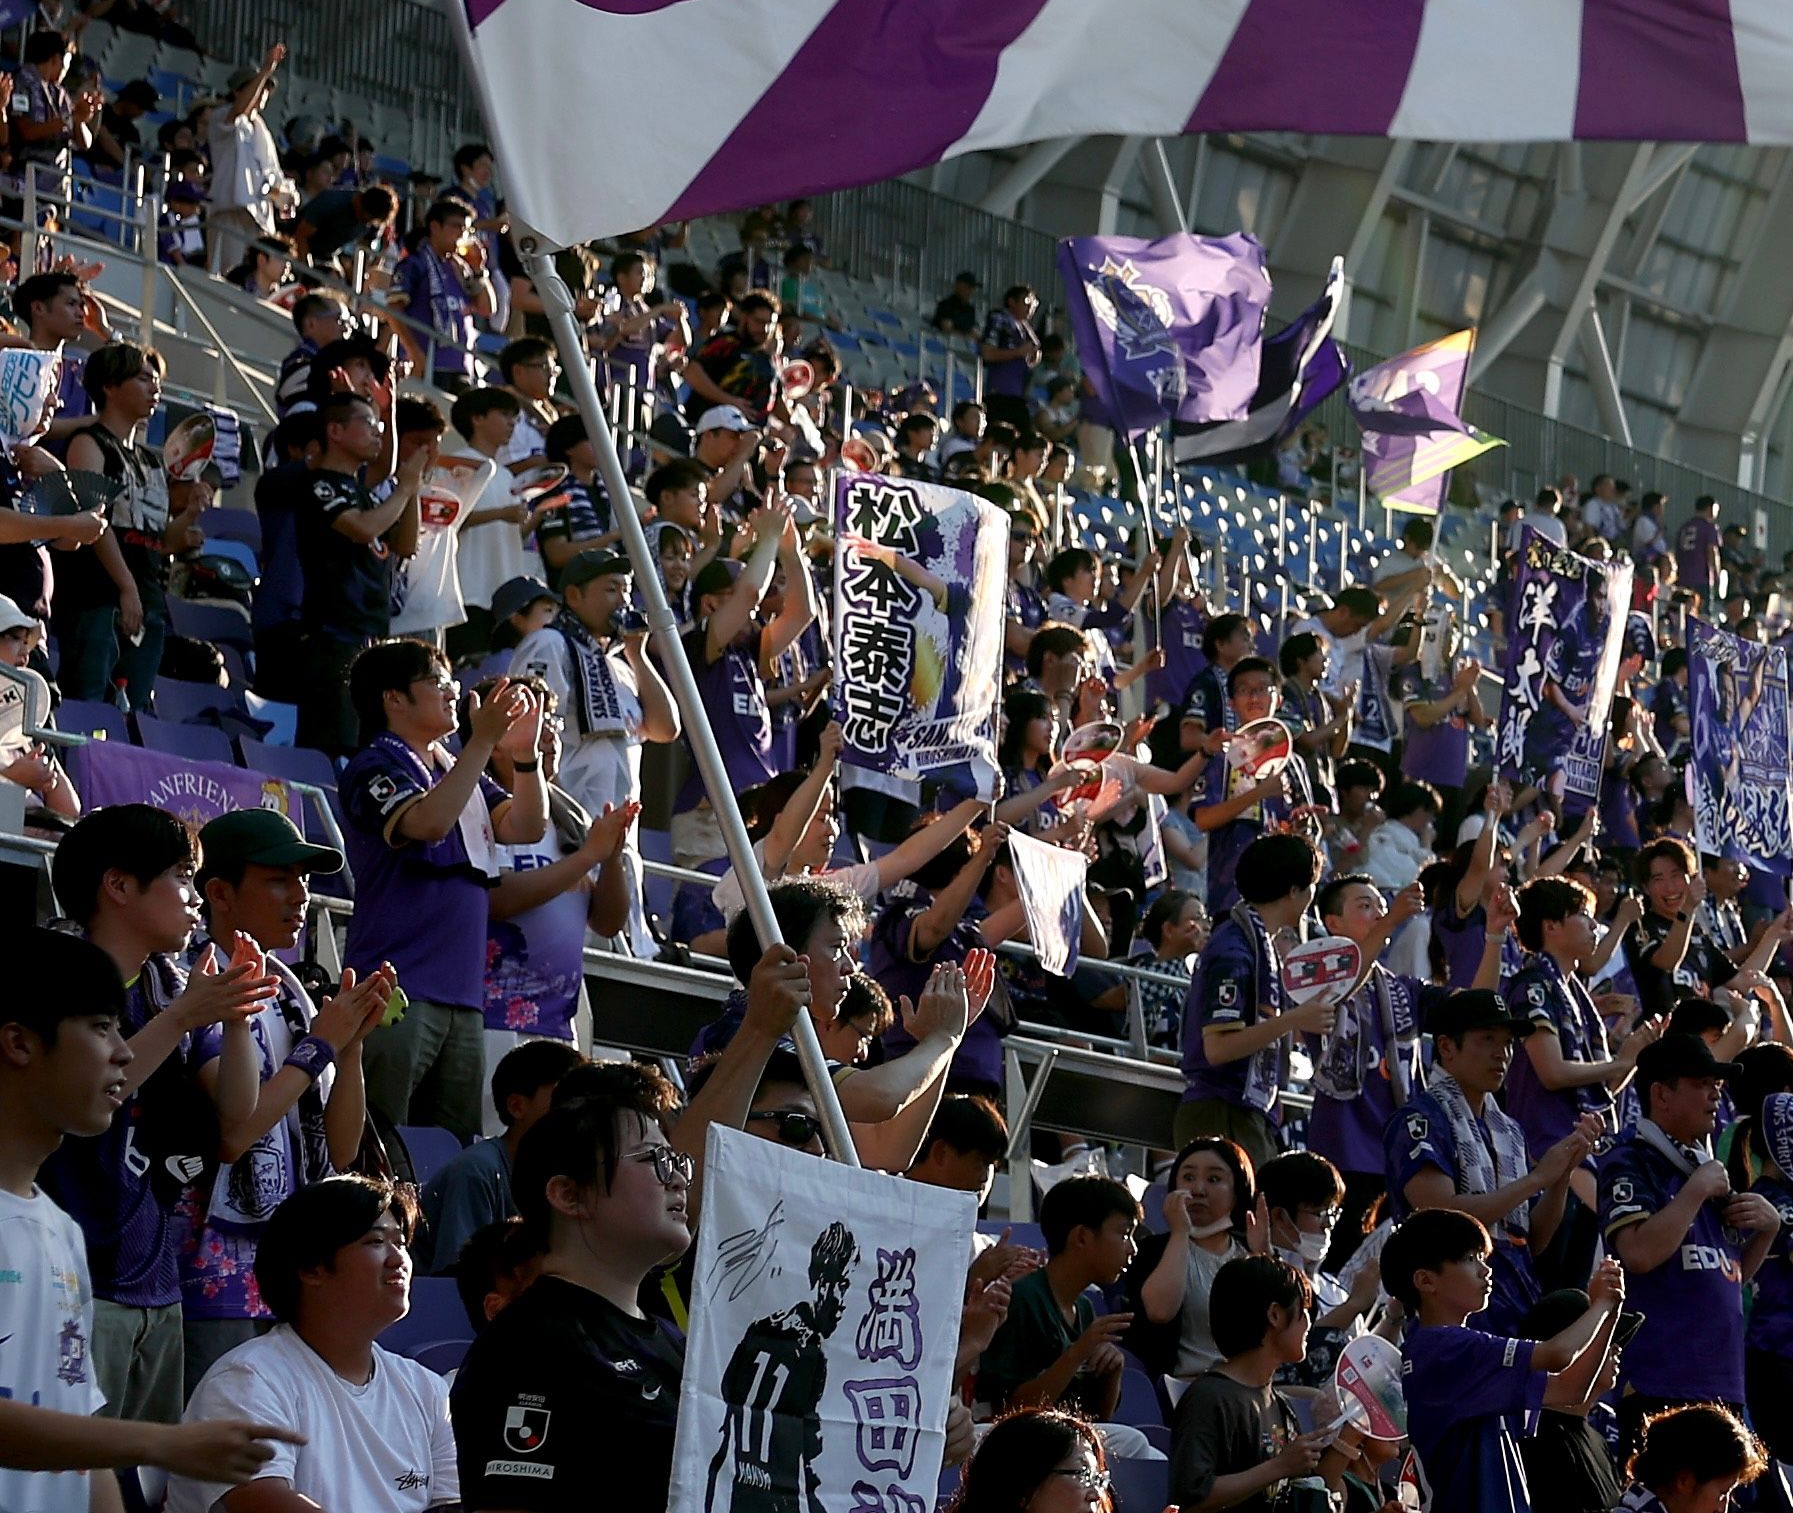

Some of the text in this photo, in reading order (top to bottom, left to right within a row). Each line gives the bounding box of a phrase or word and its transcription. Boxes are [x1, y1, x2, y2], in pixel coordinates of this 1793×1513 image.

[144, 772, 242, 814] ANFRIEN
[741, 1351, 790, 1464] 11
[843, 1247, 928, 1513] 満田
[487, 1462, 551, 1477] HIROSHIMA
